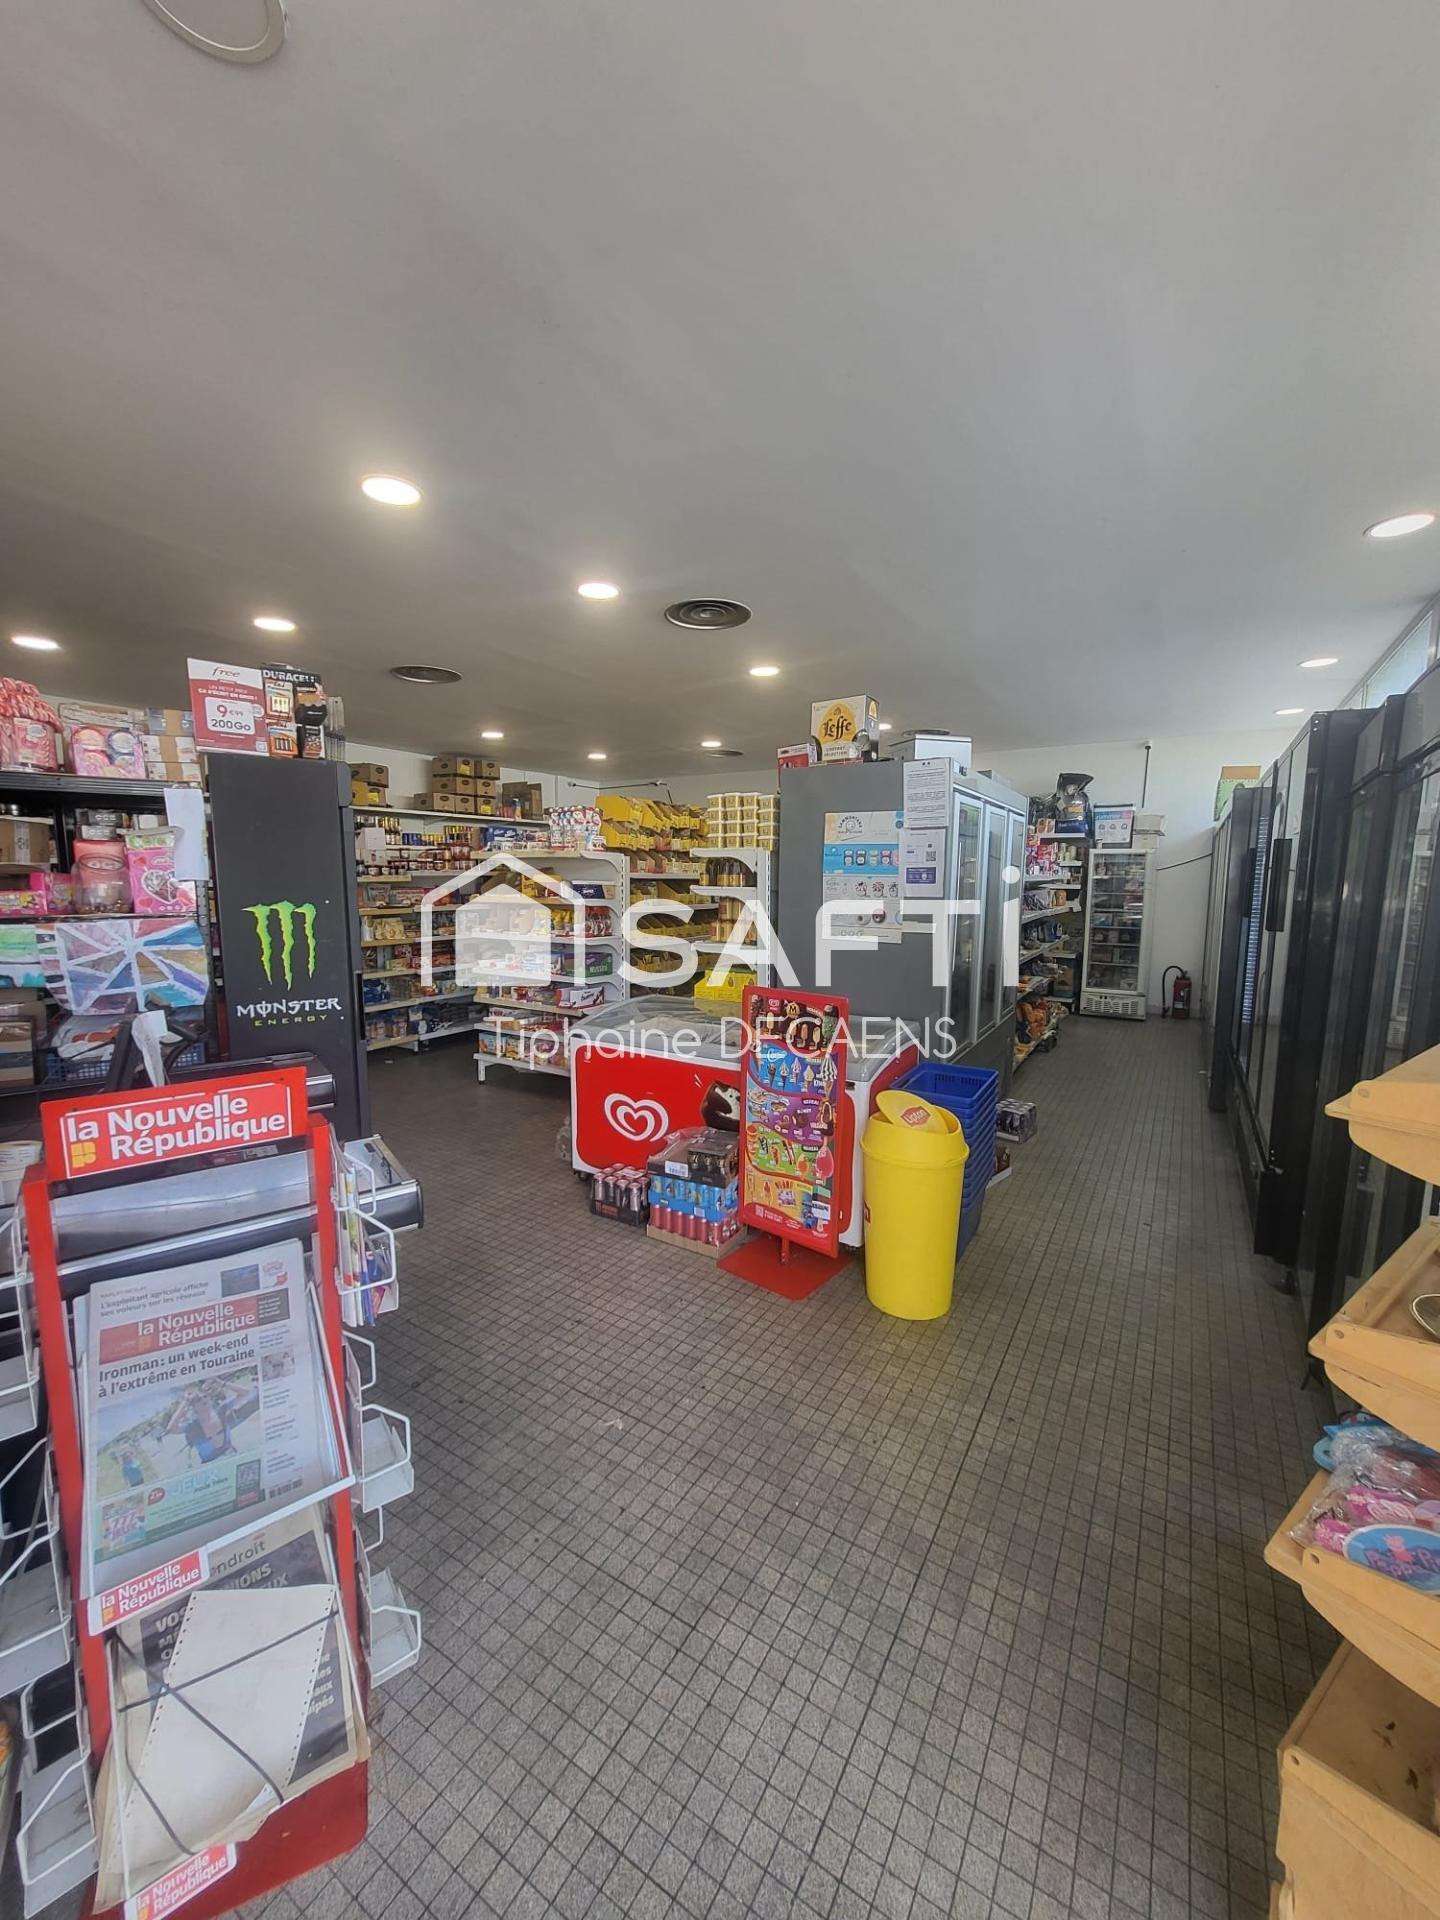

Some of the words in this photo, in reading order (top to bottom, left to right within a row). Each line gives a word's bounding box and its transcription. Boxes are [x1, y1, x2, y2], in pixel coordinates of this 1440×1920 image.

[211, 719, 251, 731] 200Go
[822, 716, 852, 740] Leffe
[236, 997, 343, 1018] MONSTER
[254, 1014, 328, 1026] ENERGY
[68, 1117, 99, 1142] la
[107, 1094, 248, 1135] Nouvelle
[902, 1109, 926, 1124] Lipton
[110, 1112, 286, 1160] République
[137, 1321, 154, 1337] la
[158, 1303, 234, 1332] Nouvelle
[158, 1314, 256, 1348] République
[168, 1353, 185, 1365] un
[188, 1334, 249, 1358] week-end
[98, 1385, 108, 1398] à
[180, 1363, 196, 1376] en
[199, 1348, 255, 1371] Touraine
[212, 1541, 266, 1577] ndroit
[102, 1594, 115, 1609] la
[118, 1564, 181, 1601] Nouvelle
[119, 1568, 200, 1615] République
[152, 1855, 209, 1896] Nouvelle
[153, 1857, 228, 1914] République
